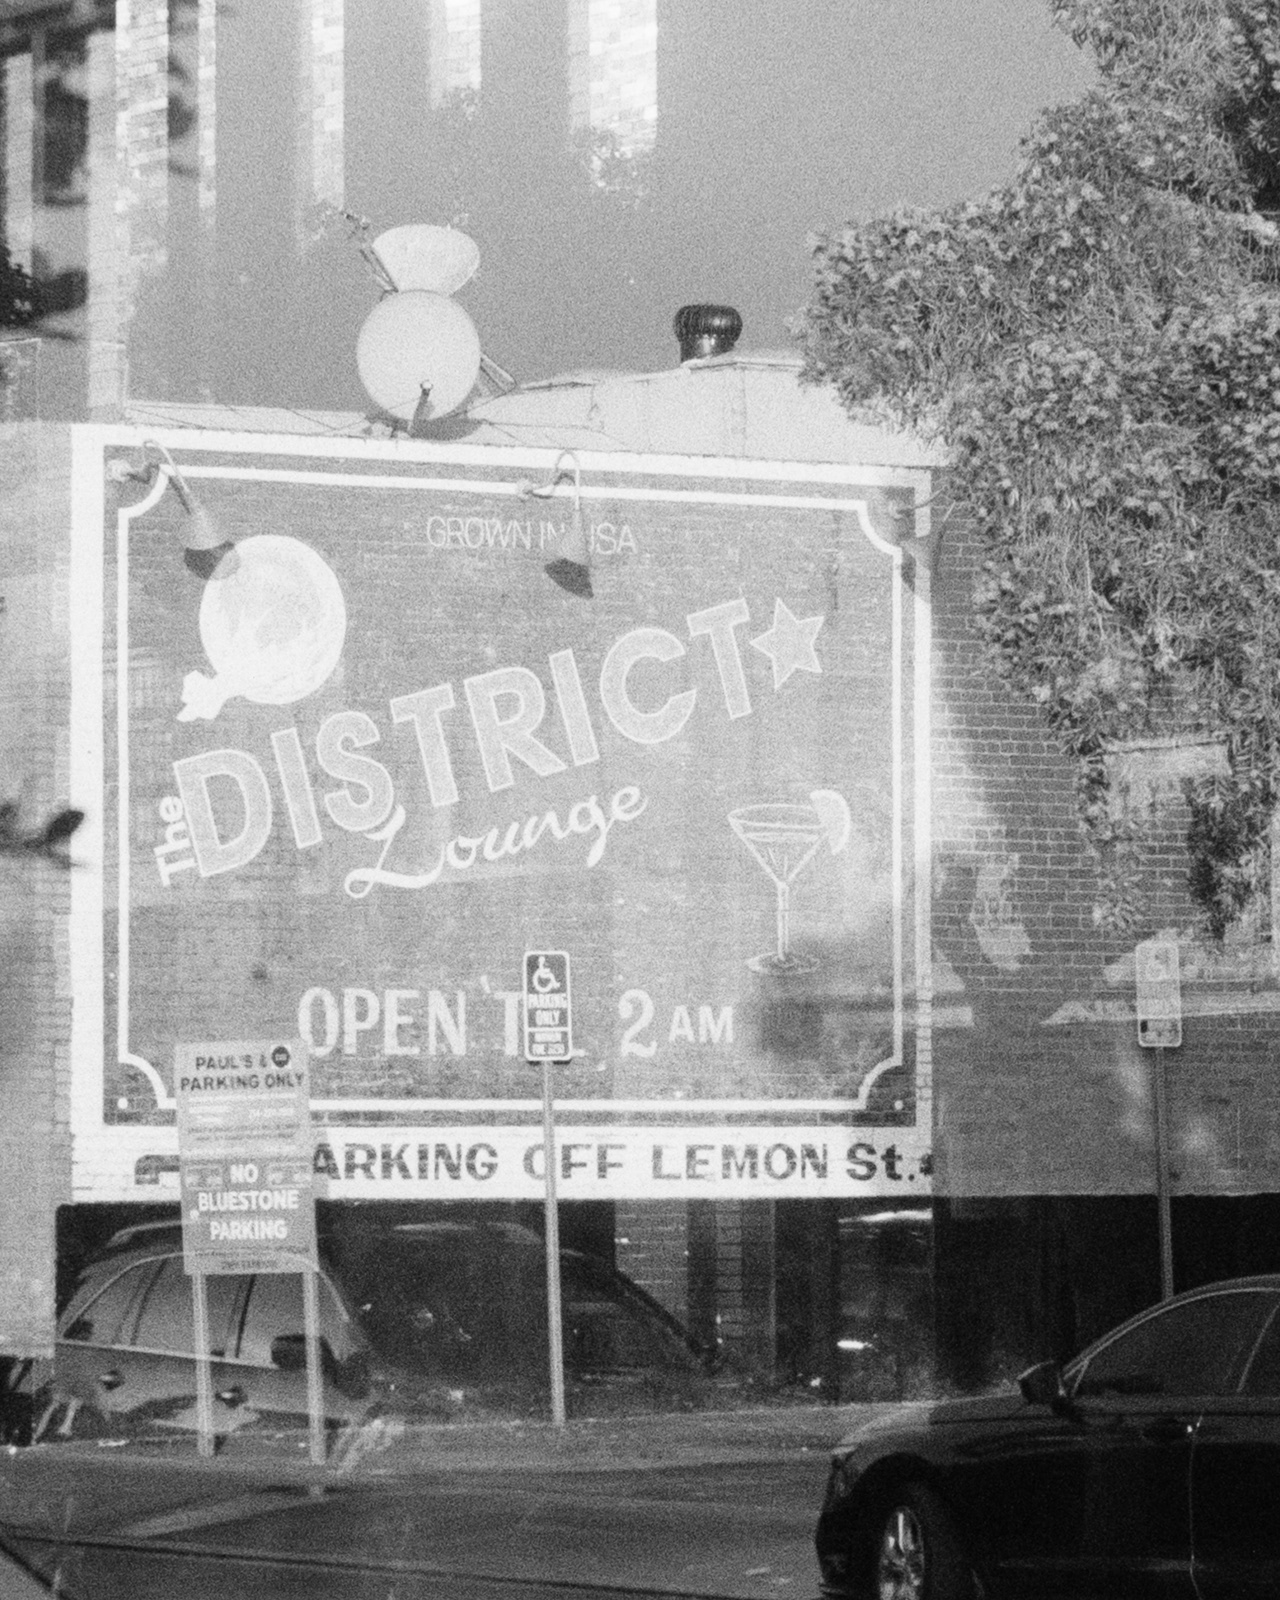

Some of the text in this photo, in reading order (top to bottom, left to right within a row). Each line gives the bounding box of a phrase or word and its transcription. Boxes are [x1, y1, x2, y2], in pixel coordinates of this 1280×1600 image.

[426, 515, 532, 551] GROWN
[172, 598, 752, 878] DISTRICT
[152, 795, 197, 887] The
[344, 785, 649, 899] Lounge
[297, 987, 467, 1057] OPEN
[619, 988, 658, 1058] 2
[668, 1005, 735, 1043] AM
[195, 1054, 254, 1070] PAUL'S
[180, 1072, 305, 1091] PARKING ONLY
[230, 1163, 259, 1184] NO
[312, 1141, 916, 1182] ARKING OFF LEMON St.
[198, 1189, 300, 1212] BLUESTONE
[210, 1219, 288, 1240] PARKING
